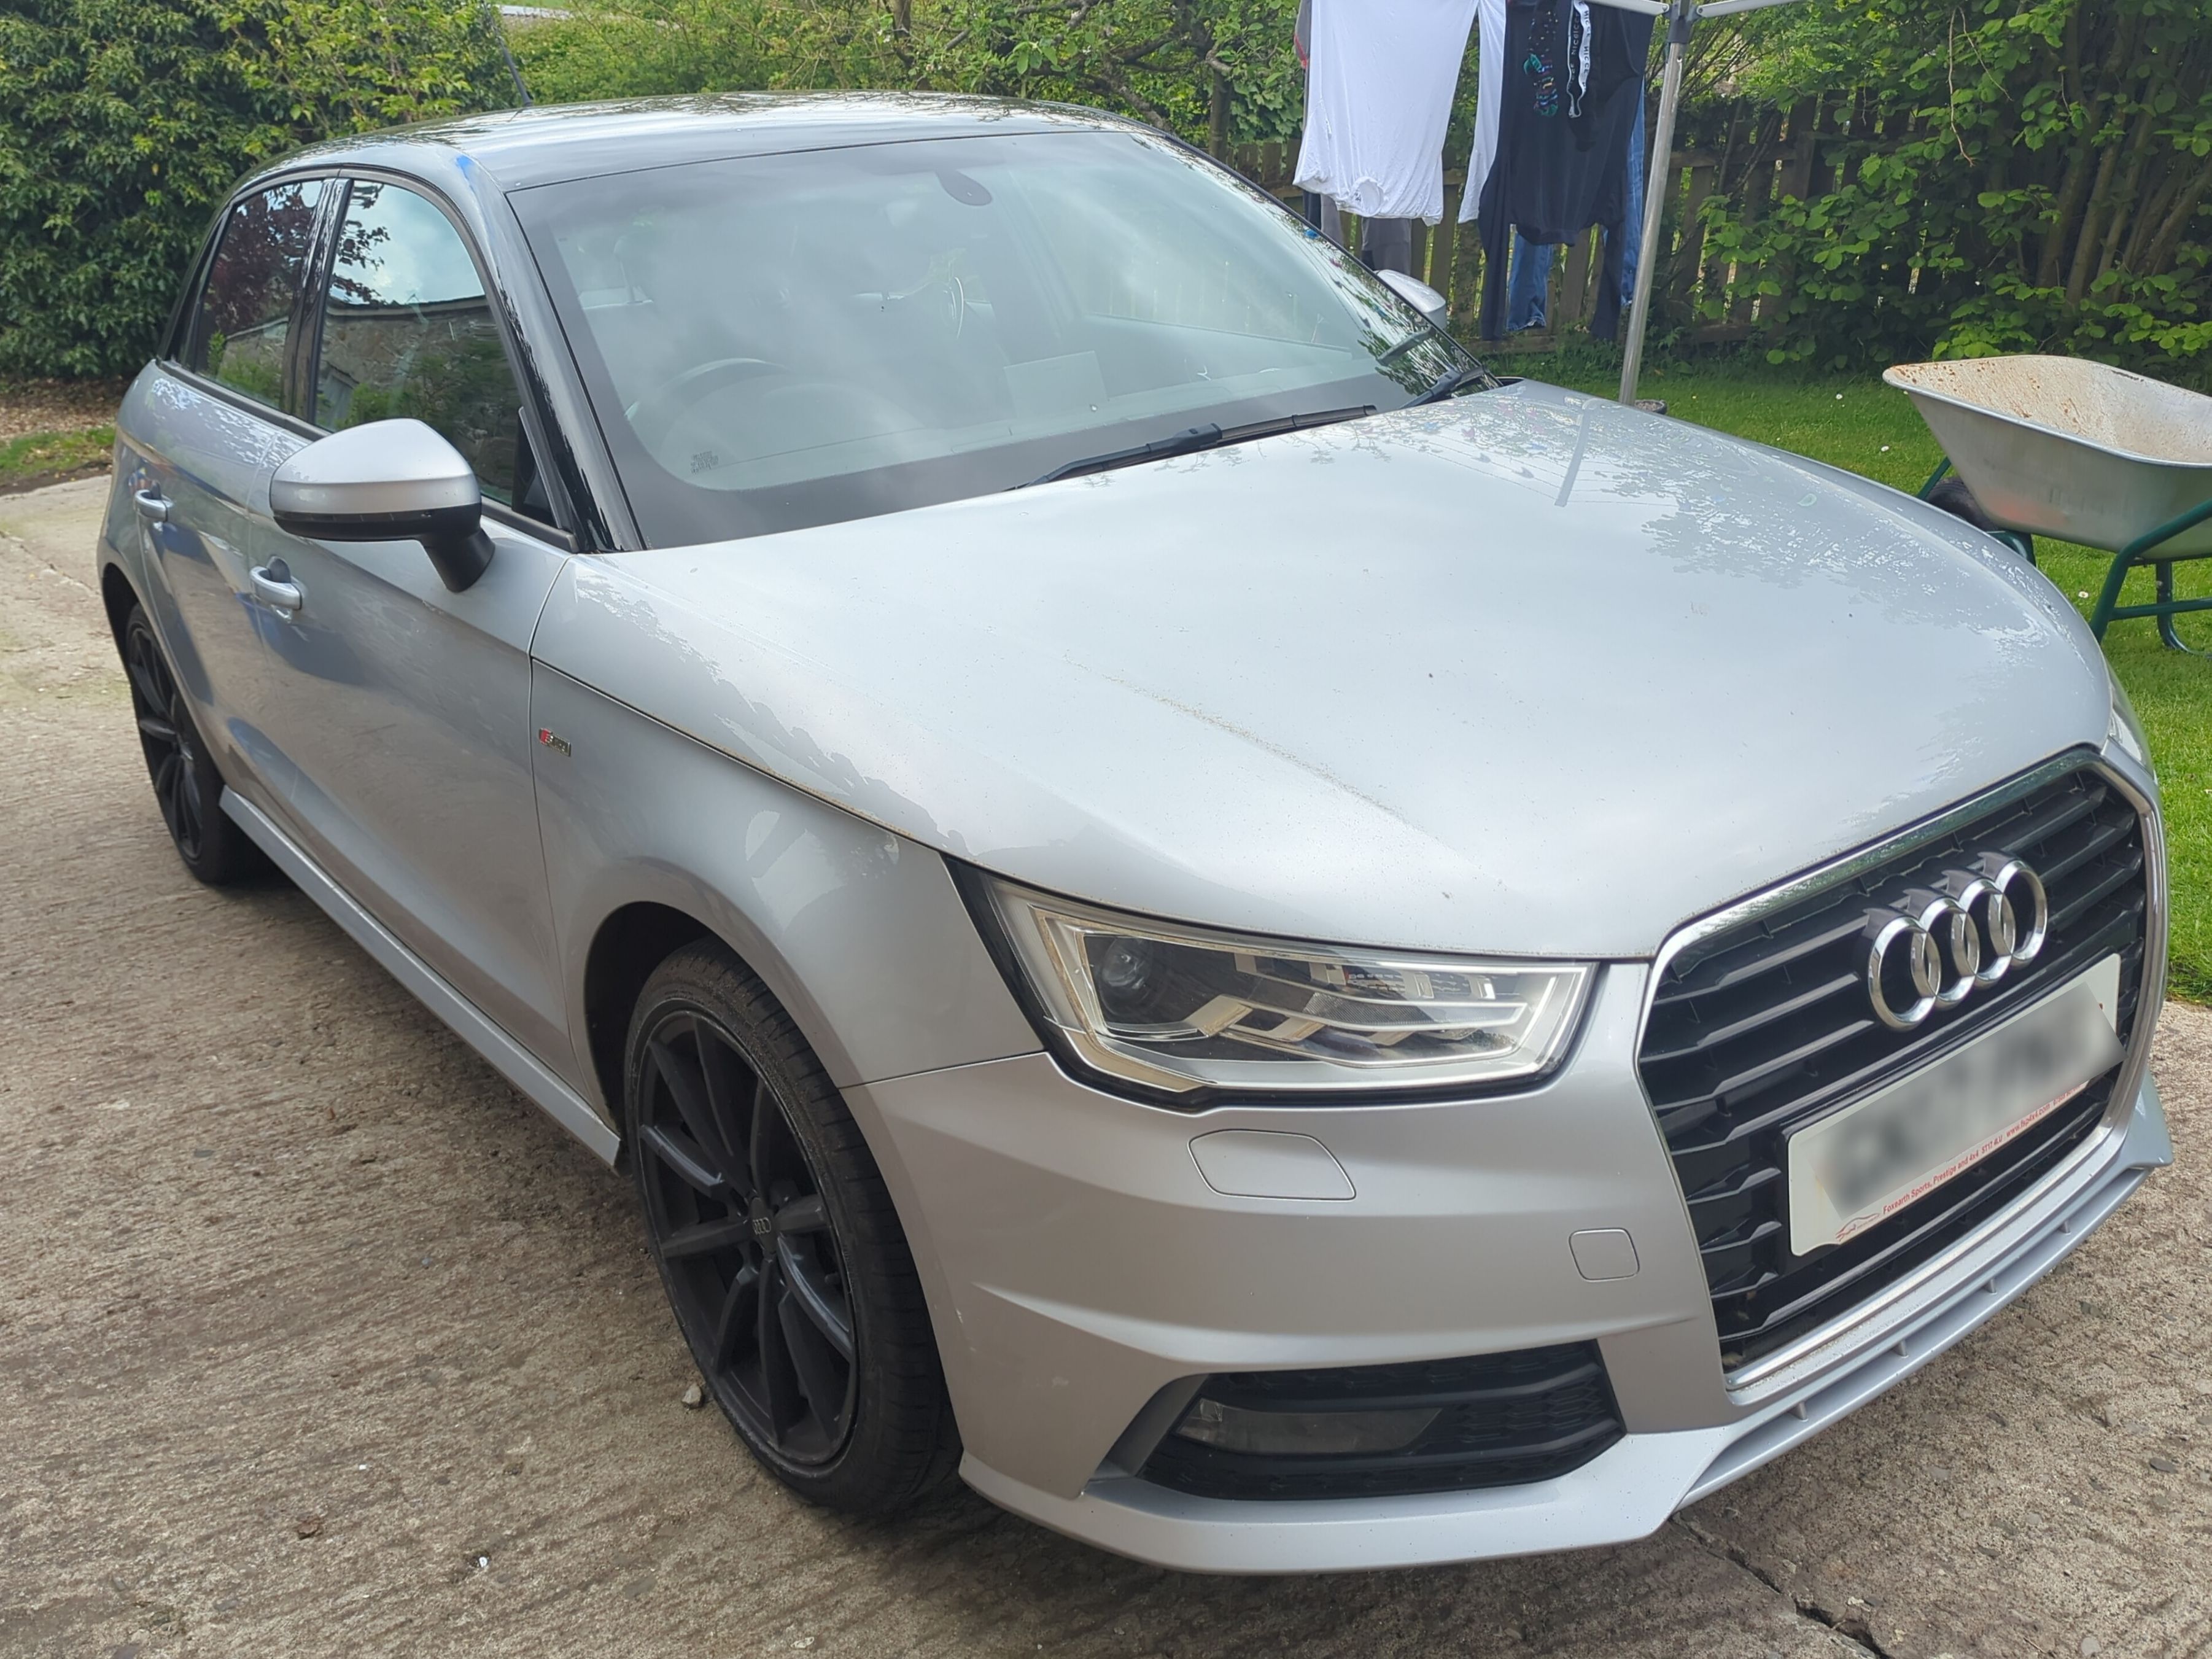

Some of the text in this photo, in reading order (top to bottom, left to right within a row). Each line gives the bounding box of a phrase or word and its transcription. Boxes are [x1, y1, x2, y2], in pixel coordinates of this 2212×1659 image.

[1883, 1194, 1910, 1214] Foxearth
[1911, 1181, 1933, 1197] Sports,
[1933, 1166, 1957, 1184] Prestige
[1957, 1156, 1968, 1168] and
[1969, 1149, 1979, 1161] 4x4
